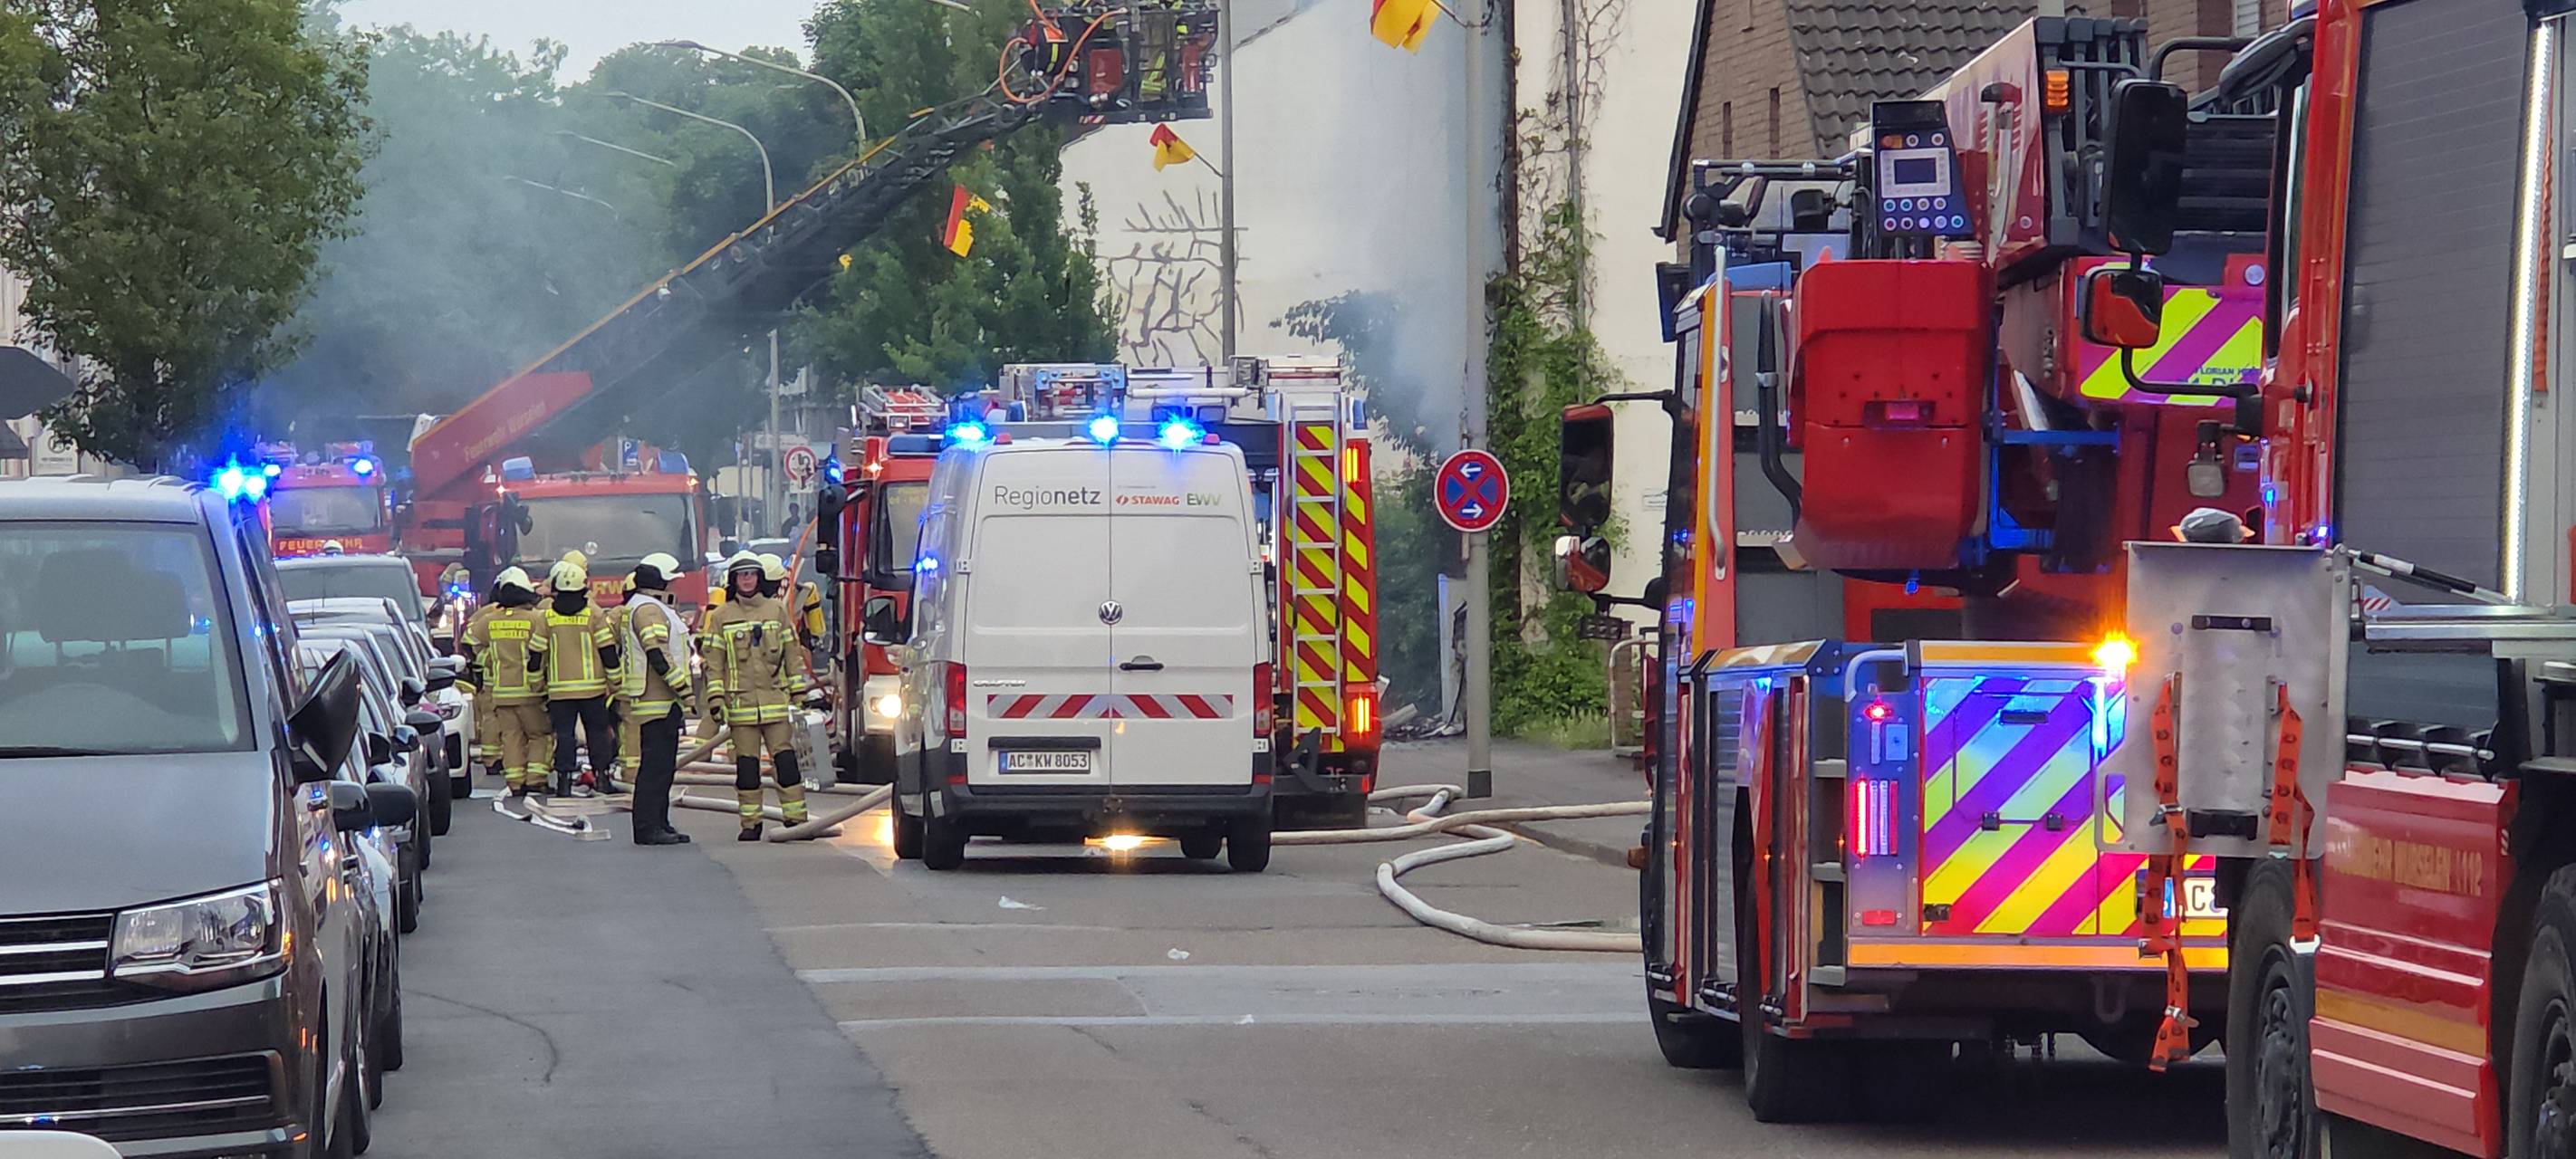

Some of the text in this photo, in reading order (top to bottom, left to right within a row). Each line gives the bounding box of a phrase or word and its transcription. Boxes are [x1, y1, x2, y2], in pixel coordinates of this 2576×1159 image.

[995, 486, 1222, 510] Regionetz STAWAG EWV
[1008, 754, 1088, 768] AC KW 8053
